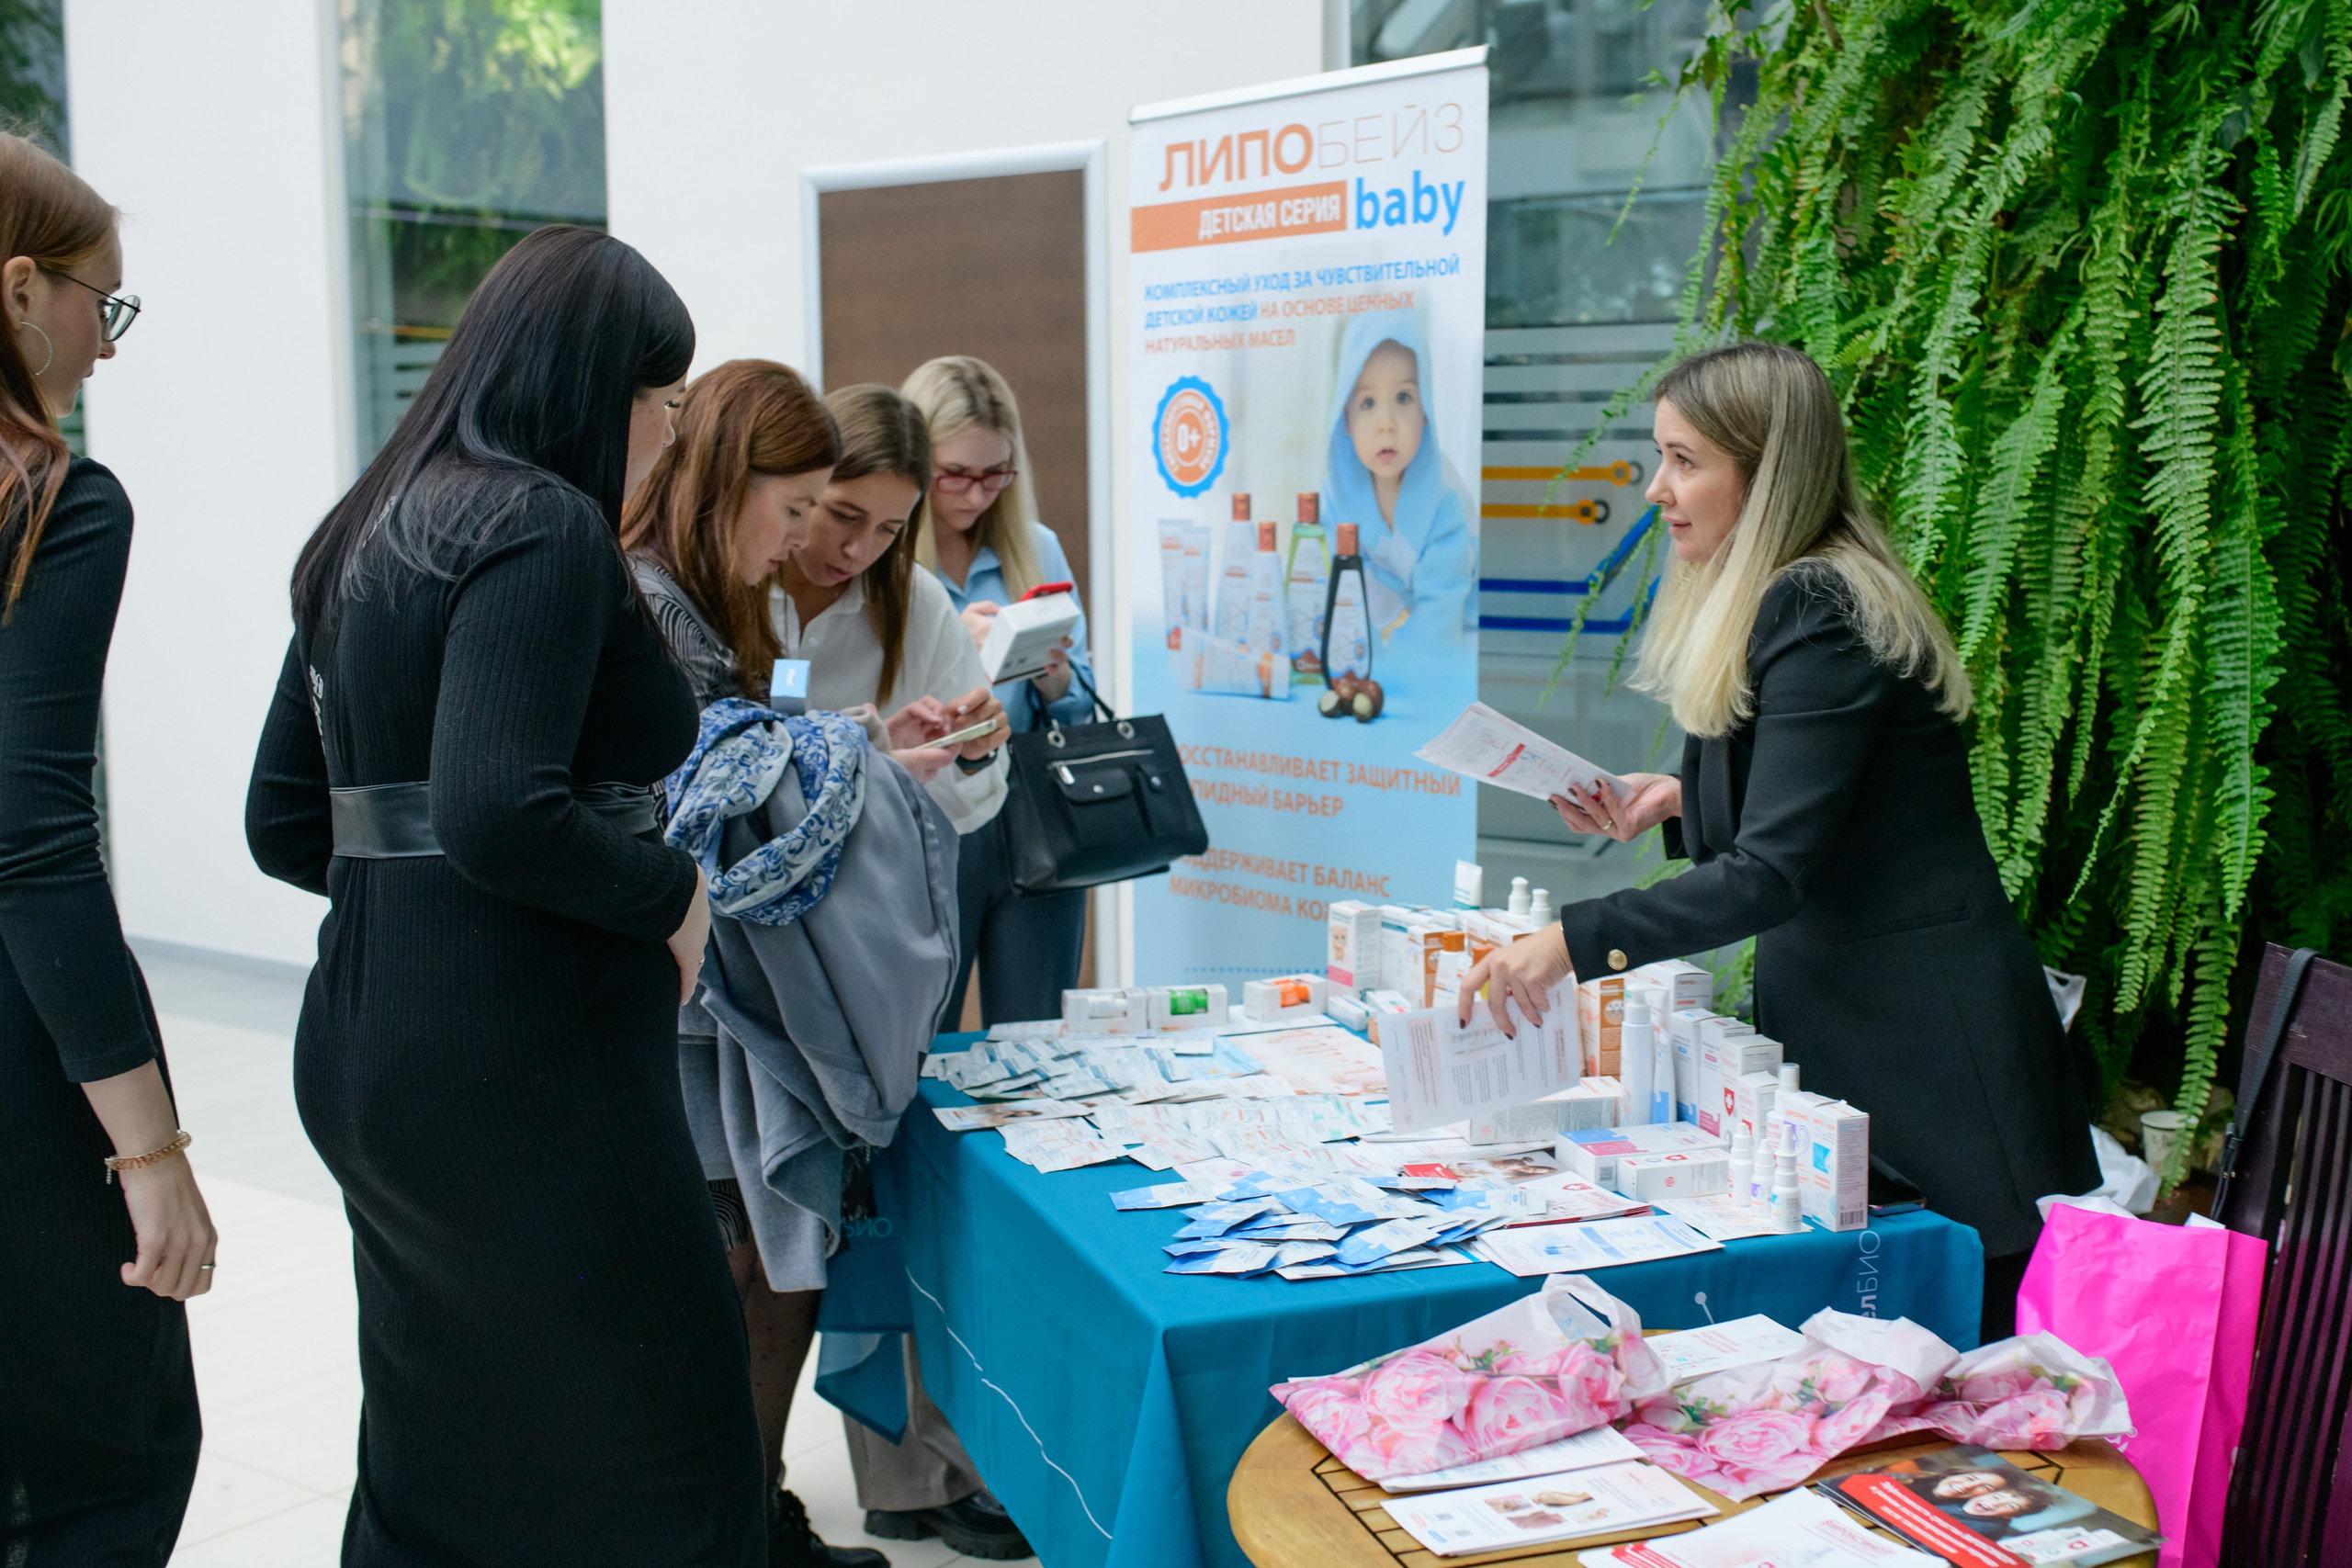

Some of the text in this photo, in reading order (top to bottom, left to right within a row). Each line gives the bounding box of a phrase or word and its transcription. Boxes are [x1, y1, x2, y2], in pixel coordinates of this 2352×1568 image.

[1159, 103, 1464, 191] ЛИПОБЕЙЗ
[1198, 194, 1341, 241] ДЕТСКАЯ СЕРИЯ
[1356, 169, 1465, 236] baby
[1145, 253, 1460, 300] КОМПЛЕКСНЫЙ УХОД ЗА ЧУВСТВИТЕЛЬНОЙ
[1144, 291, 1415, 331] ДЕТСКОЙ КОЖЕЙ НА ОСНОВЕ ЦЕННЫХ
[1145, 328, 1295, 355] НАТУРАЛЬНЫХ МАСЕЛ
[1177, 423, 1201, 454] 0+
[1177, 744, 1461, 797] ОССТАНАВЛИВАЕТ ЗАЩИТНЫЙ
[1272, 789, 1343, 817] БАРЬЕР
[1170, 874, 1293, 917] МИКРОБИОМА
[1314, 865, 1390, 897] БАЛАНС
